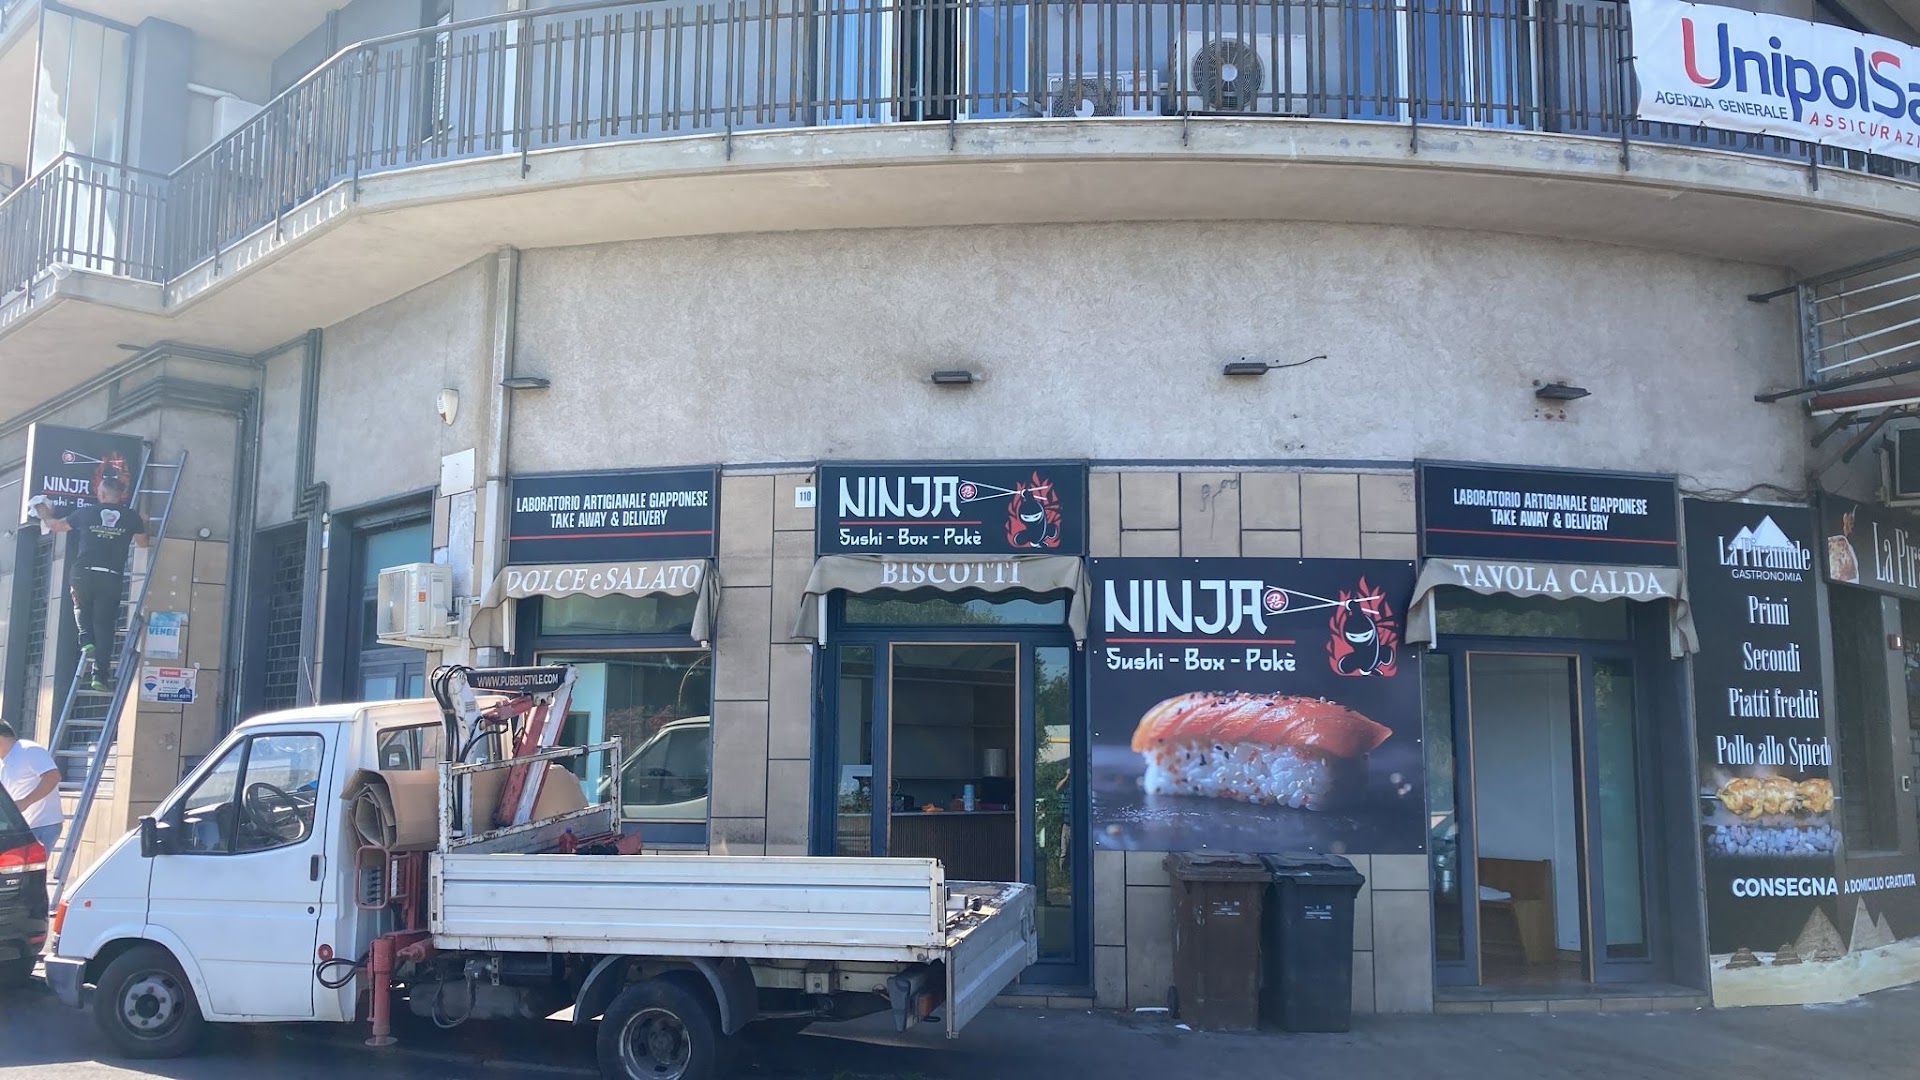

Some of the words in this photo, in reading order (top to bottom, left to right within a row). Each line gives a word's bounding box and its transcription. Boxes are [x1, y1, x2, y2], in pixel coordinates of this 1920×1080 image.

[1655, 91, 1714, 109] AGENZIA
[1719, 99, 1788, 119] GENERALE
[44, 476, 89, 494] NINJA
[799, 490, 811, 502] 110
[838, 476, 961, 518] NINJA
[516, 494, 580, 512] LABORATORIO
[583, 492, 646, 510] ARTIGIANALE
[649, 490, 708, 508] GIAPPONESE
[1453, 488, 1521, 508] LABORATORIO
[1524, 492, 1588, 513] ARTIGIANALE
[1590, 496, 1648, 516] GIAPPONESE
[550, 513, 575, 529] TAKE
[577, 511, 607, 528] AWAY
[610, 511, 619, 527] &
[622, 509, 668, 526] DELIVERY
[1491, 509, 1517, 526] TAKE
[1520, 510, 1549, 528] AWAY
[1553, 512, 1562, 528] &
[1565, 513, 1609, 531] DELIVERY
[839, 528, 882, 546] Sushi
[898, 528, 928, 546] Box
[944, 528, 982, 546] Pokè
[1718, 536, 1738, 566] La
[1741, 537, 1811, 570] Piramide
[1872, 521, 1894, 583] La
[1895, 528, 1920, 588] Pir
[507, 568, 588, 592] DOLCE
[590, 573, 602, 591] e
[604, 564, 702, 591] SALATO
[881, 561, 1020, 585] BISCOTTI
[1453, 564, 1562, 593] TAVOLA
[1570, 568, 1665, 595] CALDA
[1731, 569, 1803, 582] GASTRONOMIA
[1104, 580, 1268, 635] NINJA
[1748, 595, 1790, 626] Primi
[1106, 647, 1163, 670] Sushi
[1184, 648, 1225, 671] Box
[1246, 648, 1296, 672] Pokè
[1743, 641, 1801, 672] Secondi
[477, 673, 559, 688] WWW.PUBBLISTYLE.COM
[1728, 687, 1771, 718] Piatti
[1774, 687, 1820, 719] freddi
[1716, 734, 1754, 765] Pollo
[1758, 735, 1785, 765] allo
[1731, 877, 1839, 897] CONSEGNA
[1844, 880, 1850, 894] A
[1850, 876, 1884, 894] DOMICILIO
[1885, 873, 1917, 889] GRATUITA
